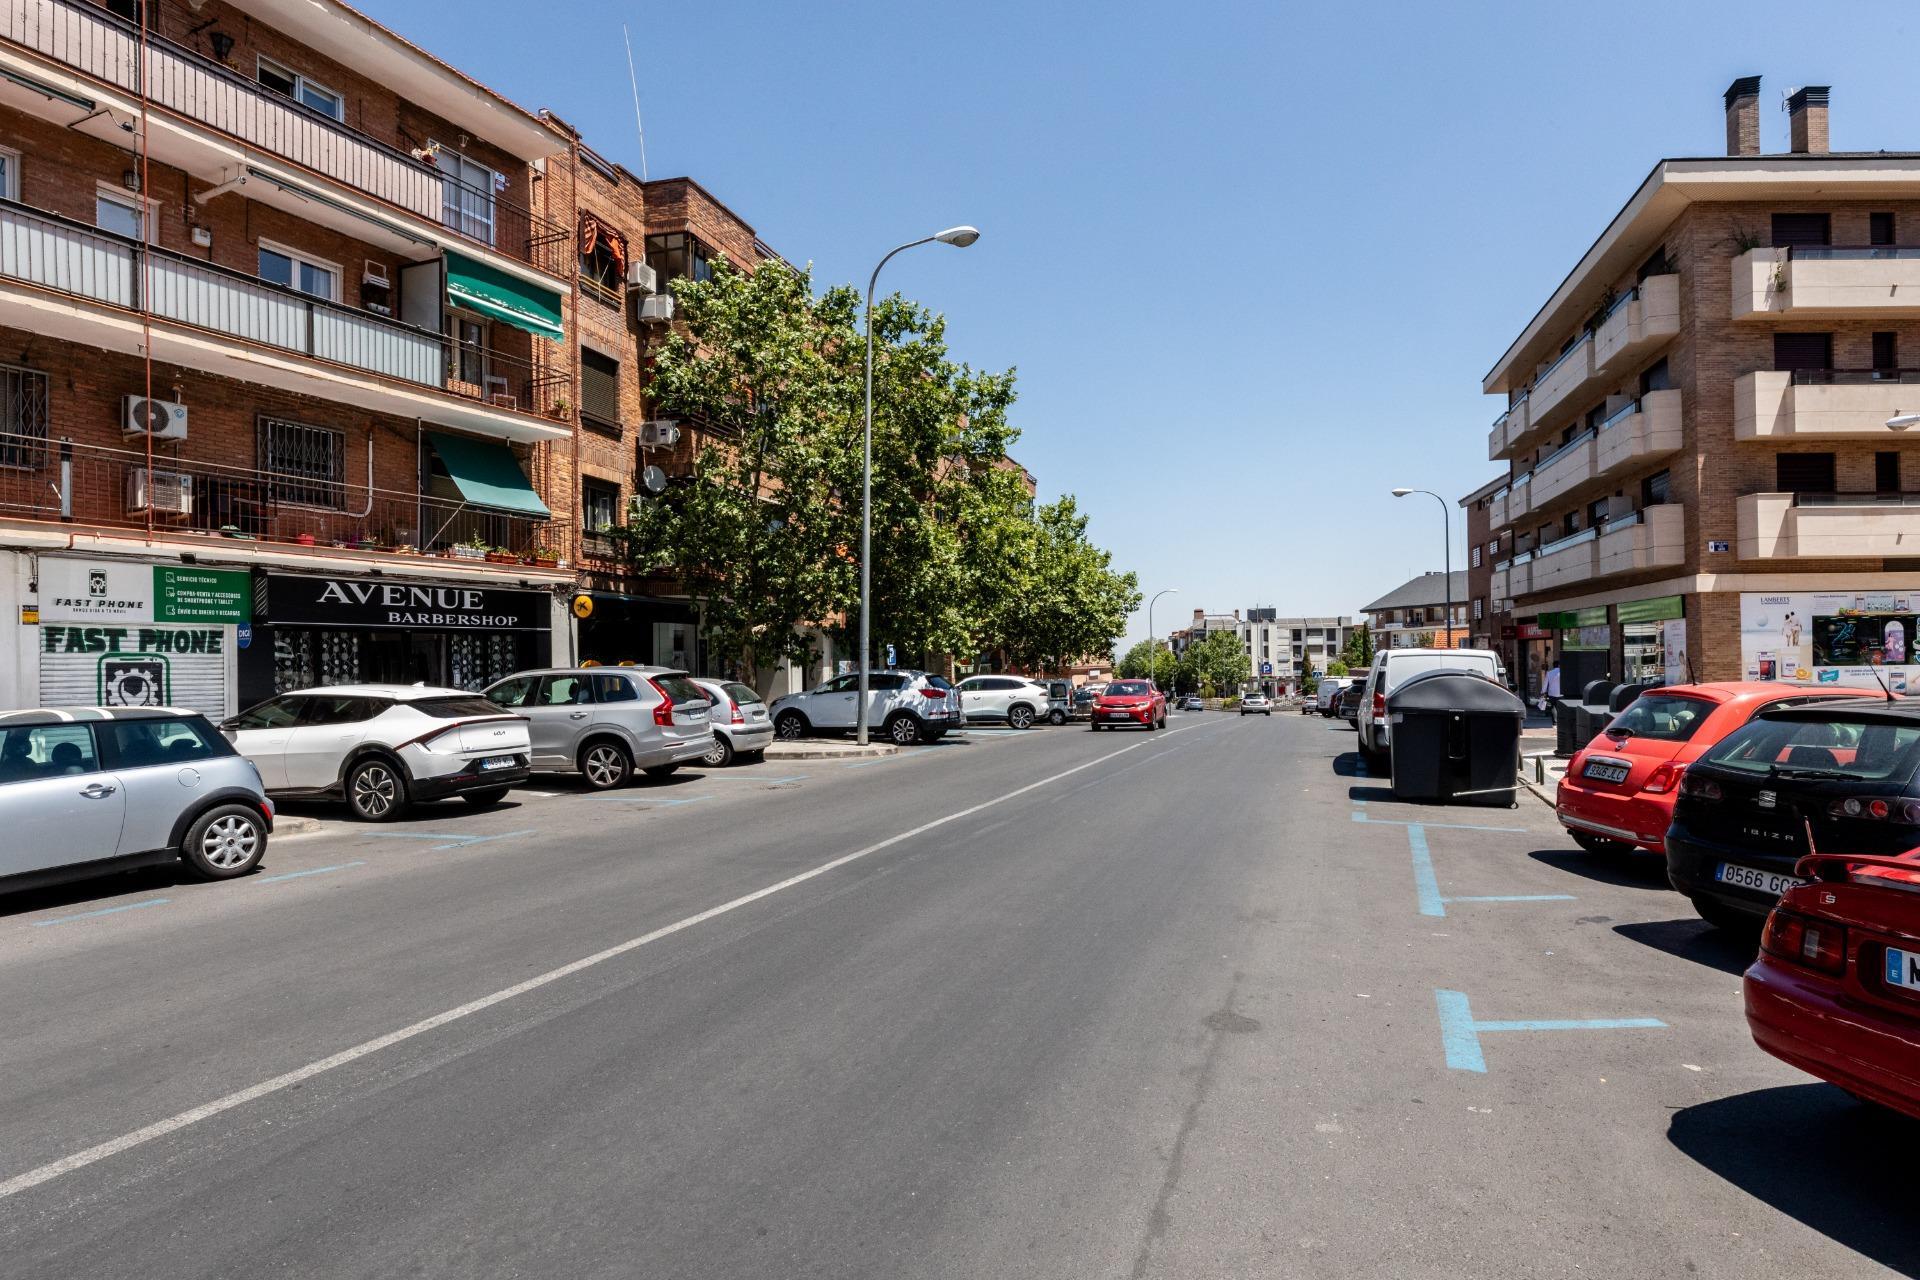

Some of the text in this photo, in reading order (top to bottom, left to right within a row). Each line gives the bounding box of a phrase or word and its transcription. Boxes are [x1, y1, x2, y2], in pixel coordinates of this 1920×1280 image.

[316, 581, 484, 610] AVENUE
[55, 598, 144, 609] FAST PHONE
[388, 612, 518, 626] BARBERSHOP
[238, 629, 251, 637] DIGI
[44, 627, 225, 654] FAST PHONE
[1263, 665, 1271, 674] P
[1608, 768, 1624, 780] JLC
[1743, 827, 1794, 840] IBIZA
[1725, 866, 1764, 888] 0566
